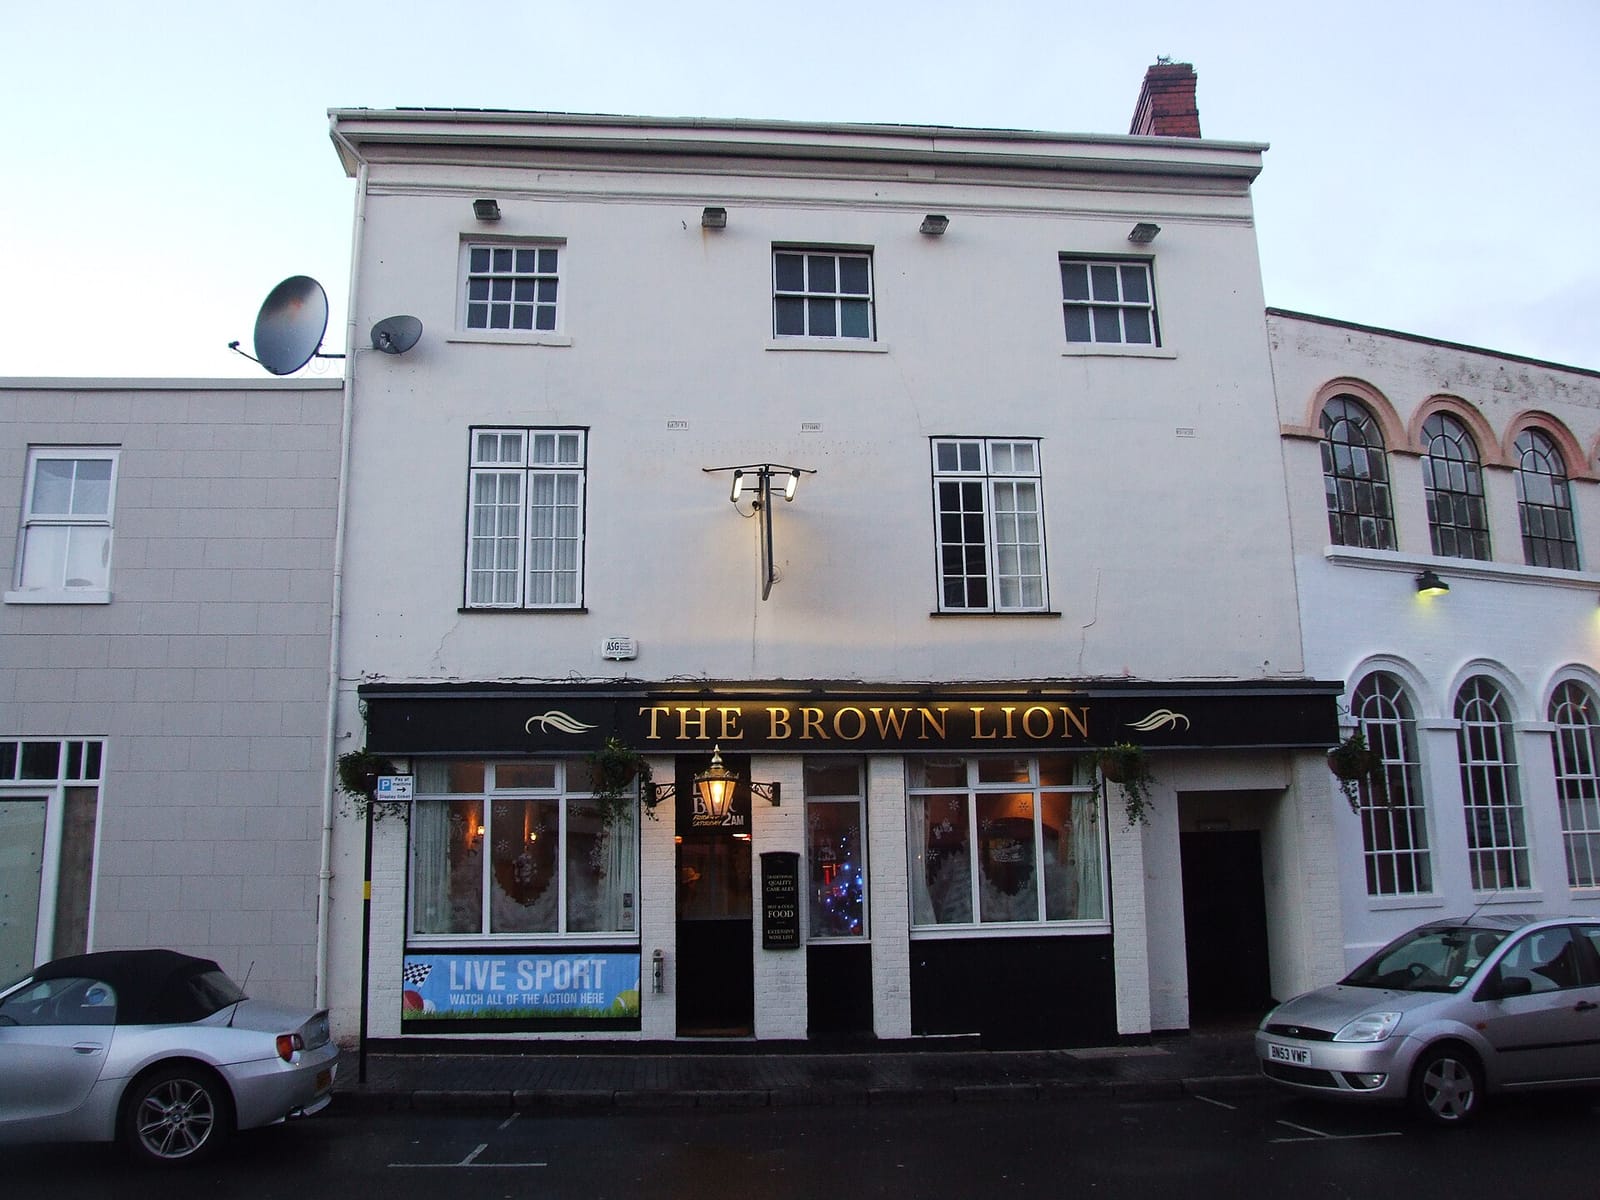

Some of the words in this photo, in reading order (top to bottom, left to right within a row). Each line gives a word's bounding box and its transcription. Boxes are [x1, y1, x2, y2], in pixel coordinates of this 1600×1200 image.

[606, 642, 619, 651] ASG
[638, 706, 744, 740] THE
[766, 706, 947, 740] BROWN
[970, 706, 1090, 740] LION
[721, 812, 744, 826] 2AM
[768, 909, 794, 918] FOOD
[451, 960, 506, 991] LIVE
[517, 959, 607, 991] SPORT
[450, 993, 483, 1005] WATCH
[486, 993, 503, 1005] ALL
[507, 993, 519, 1005] OF
[522, 993, 539, 1005] THE
[543, 993, 577, 1005] ACTION
[581, 992, 604, 1004] HERE
[1271, 1046, 1290, 1060] BN53
[1291, 1049, 1308, 1063] VWF
